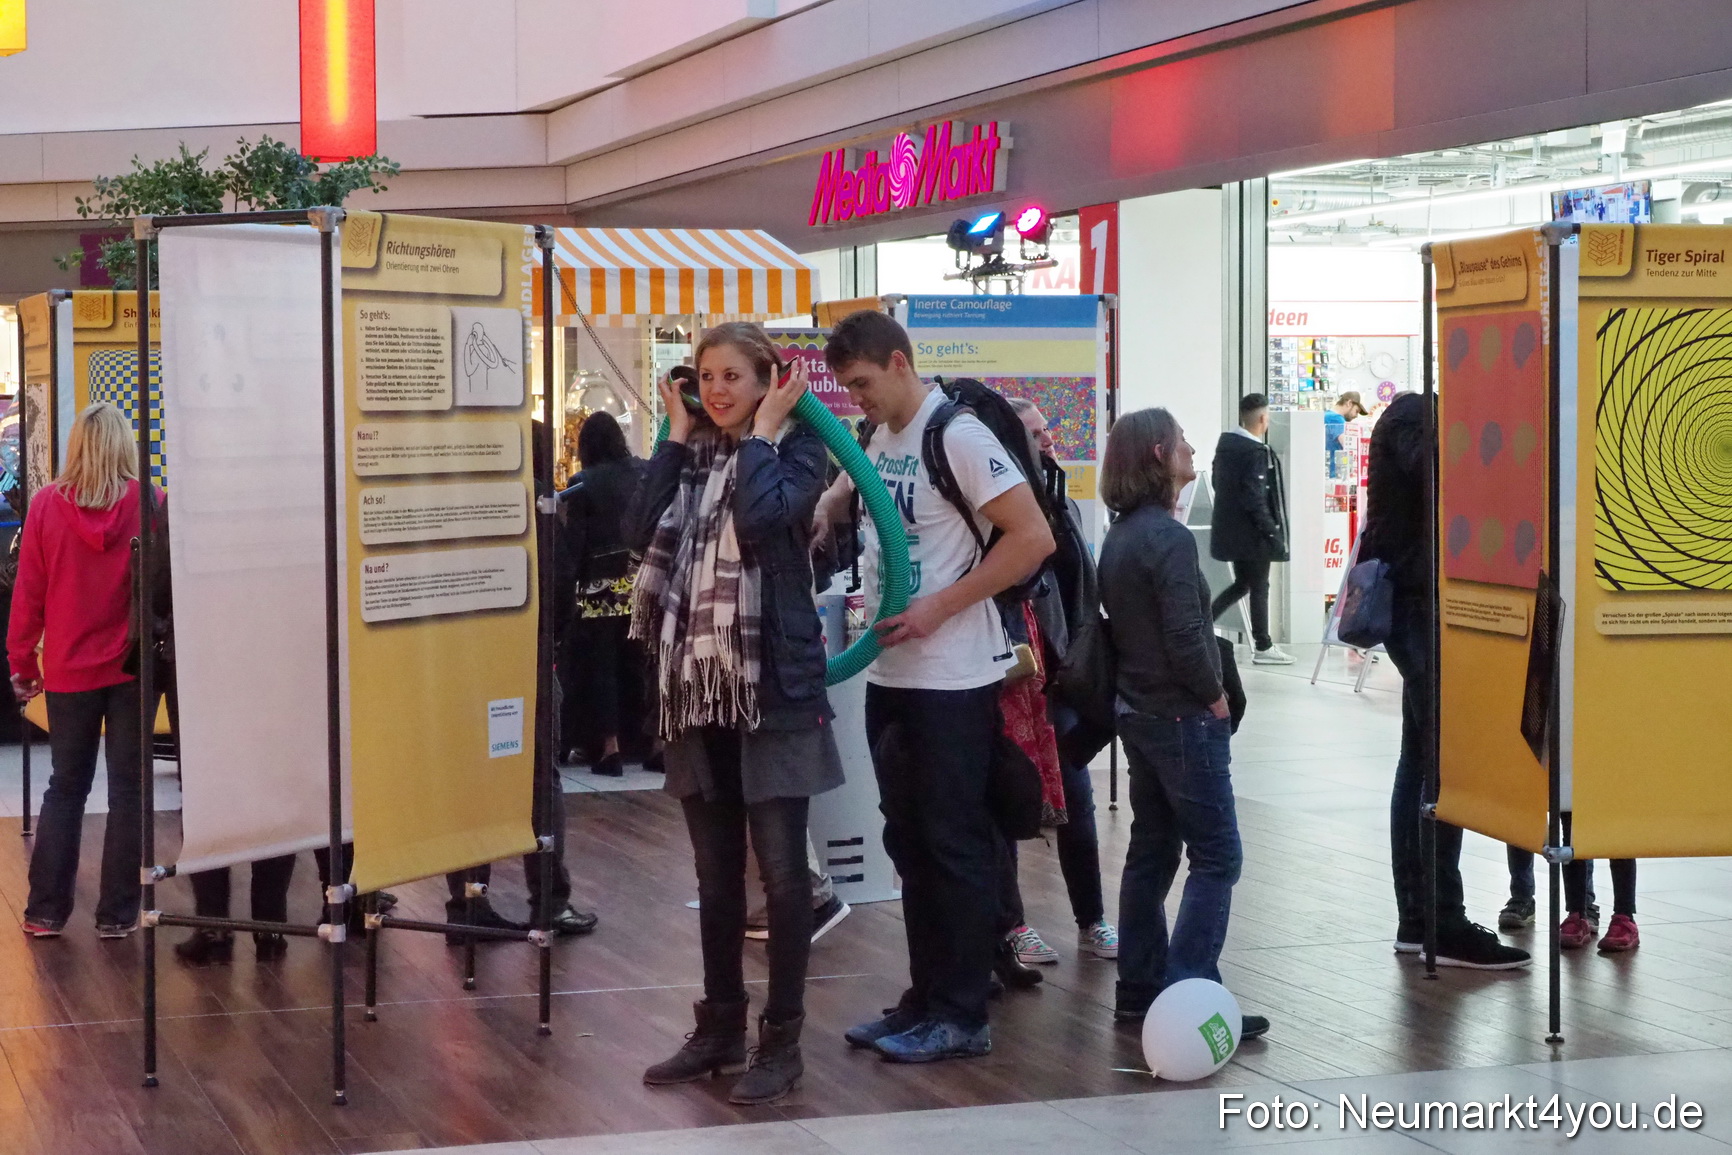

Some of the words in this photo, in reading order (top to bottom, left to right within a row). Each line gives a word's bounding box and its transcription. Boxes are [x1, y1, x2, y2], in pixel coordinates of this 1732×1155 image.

[807, 147, 890, 226] Media
[908, 120, 1001, 208] Markt
[386, 240, 456, 260] Richtungshören
[1490, 257, 1500, 270] des
[1500, 255, 1522, 269] Gehirns
[1645, 249, 1682, 266] Tiger
[1684, 249, 1725, 266] Spiral
[386, 261, 420, 274] Orientierung
[420, 264, 429, 273] mit
[429, 264, 442, 274] zwei
[442, 264, 460, 274] Ohren
[1645, 268, 1680, 277] Tendenz
[1696, 269, 1718, 277] Mitte
[914, 299, 947, 310] Inerte
[950, 299, 1013, 312] Camouflage
[360, 309, 369, 320] So
[369, 310, 391, 322] geht's:
[917, 342, 933, 355] So
[936, 342, 979, 358] geht's:
[357, 430, 379, 441] Nanu!?
[876, 451, 920, 477] CrossFit
[363, 496, 375, 505] Ach
[375, 495, 386, 505] so!
[365, 564, 373, 574] Na
[374, 562, 389, 573] und?
[492, 741, 519, 752] SIEMENS
